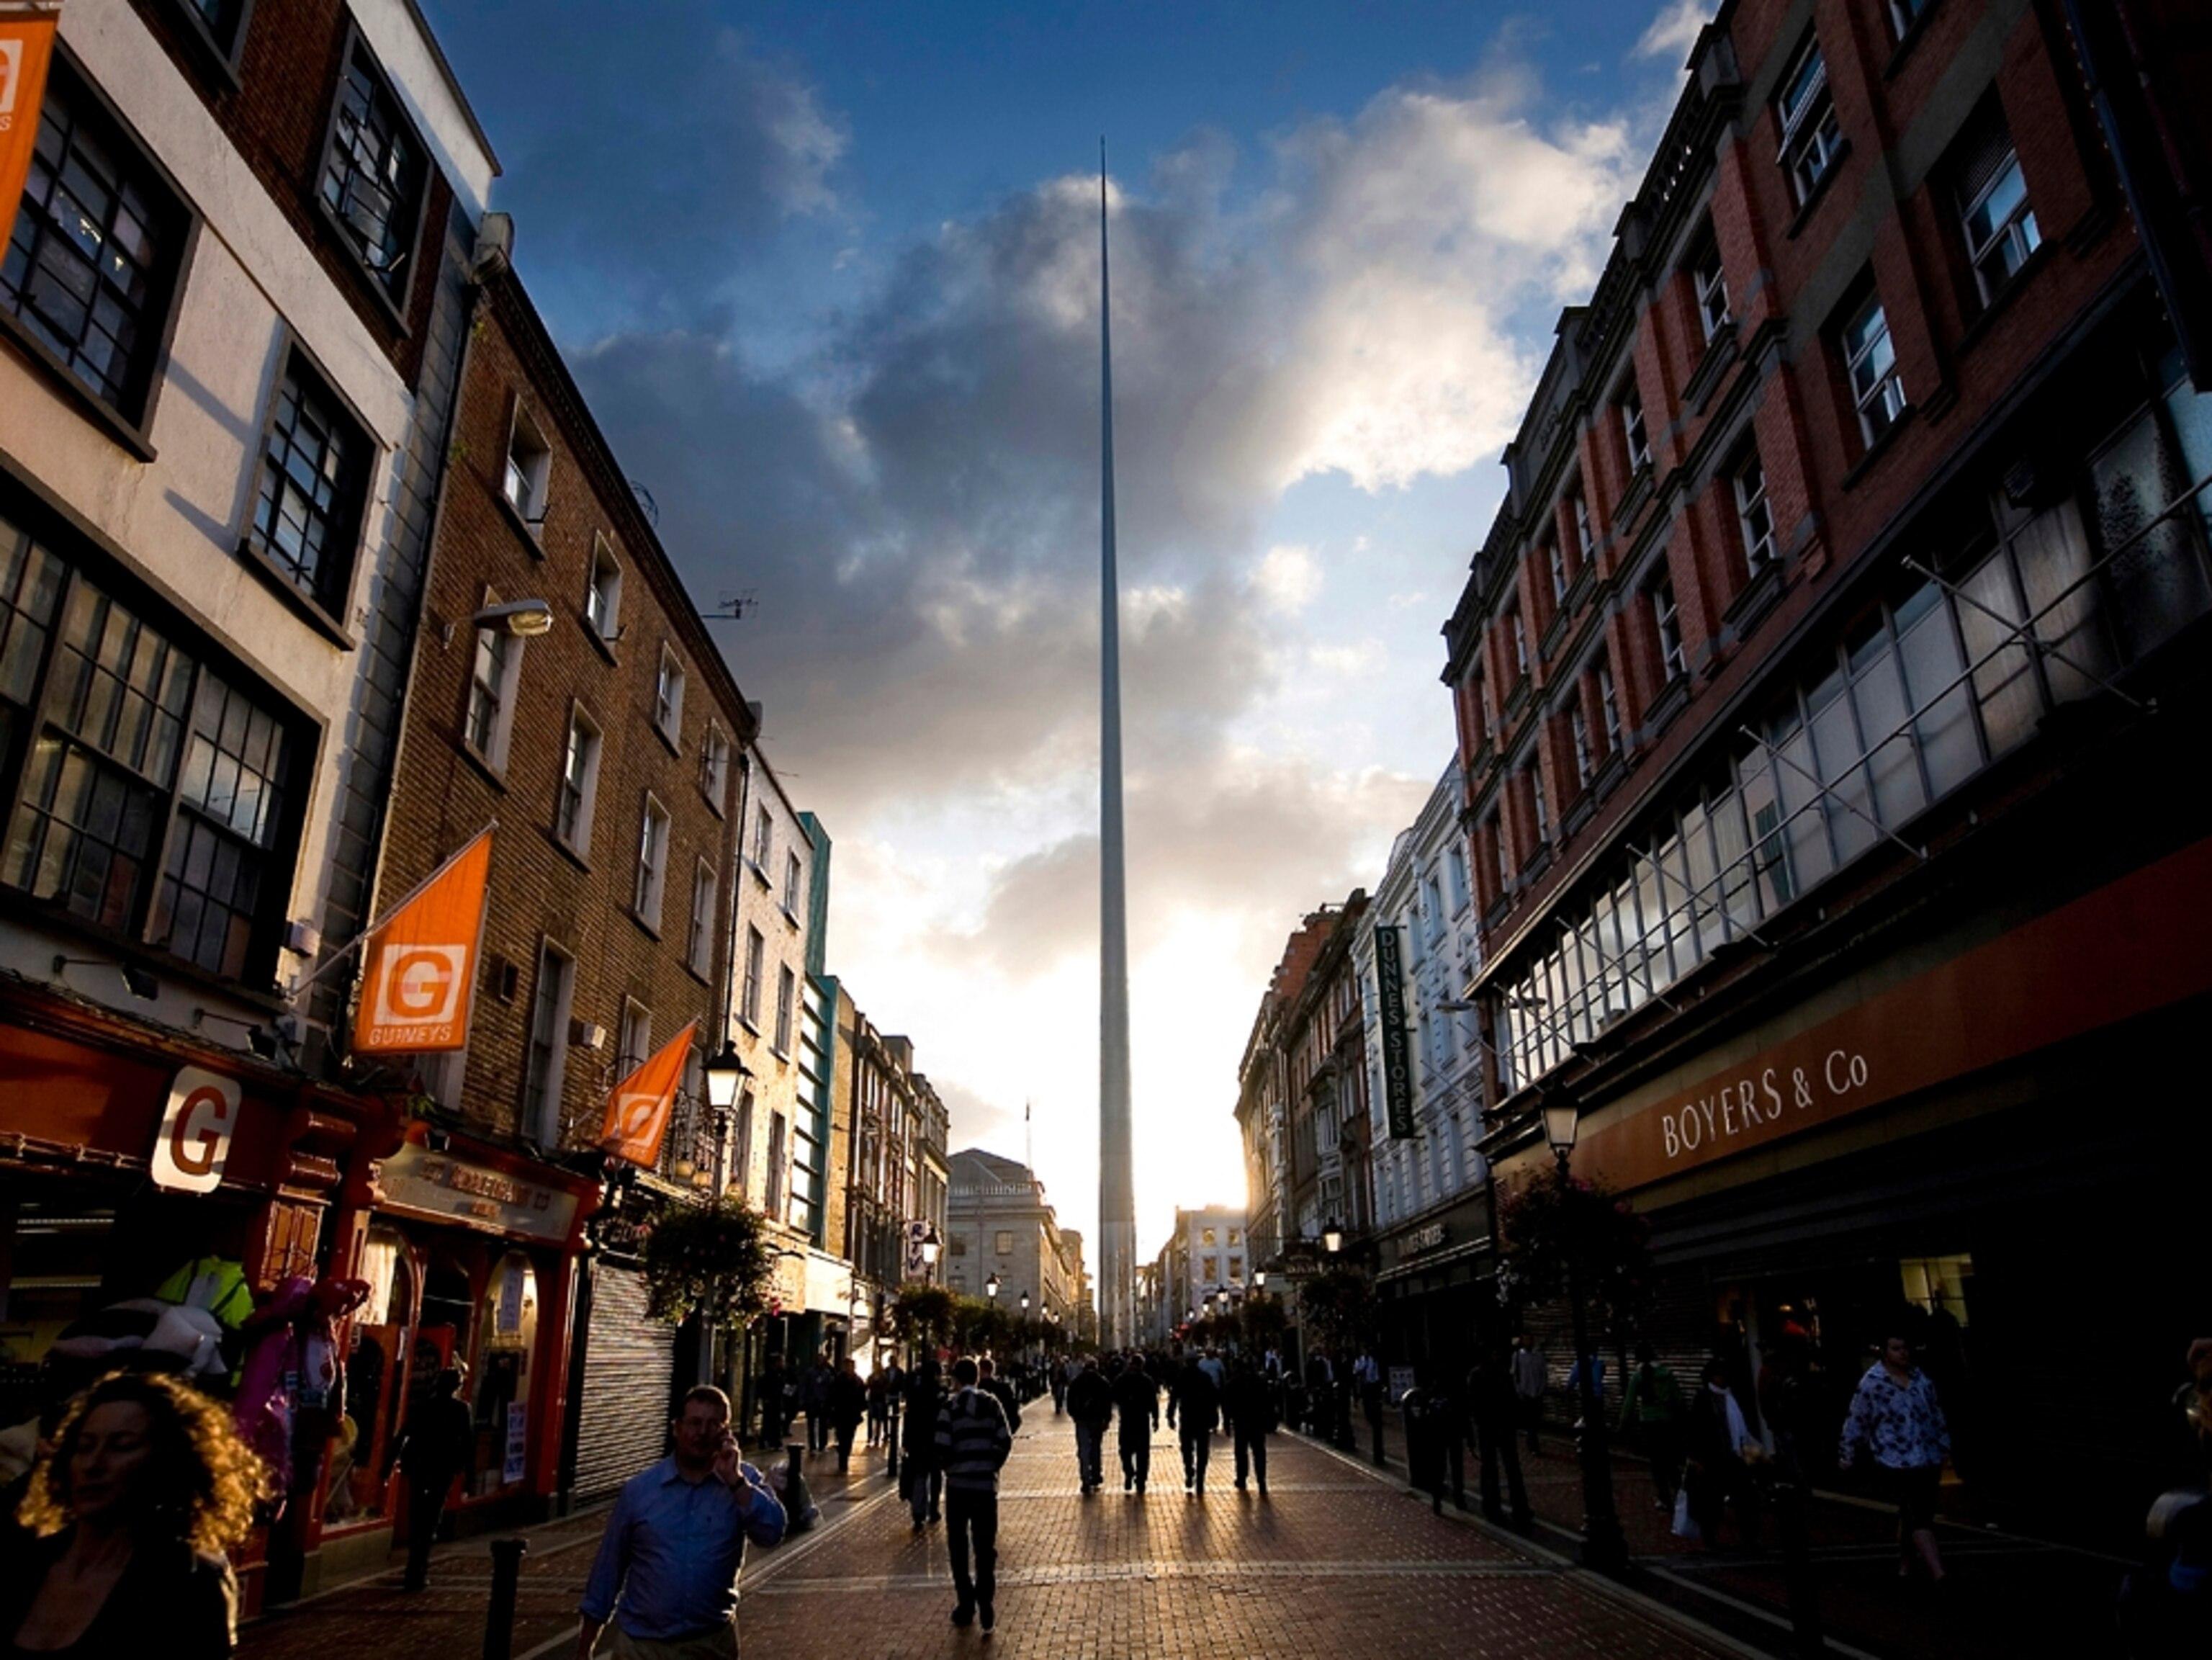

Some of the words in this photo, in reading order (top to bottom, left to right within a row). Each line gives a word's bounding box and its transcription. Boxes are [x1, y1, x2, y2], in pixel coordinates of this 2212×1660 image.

[387, 951, 453, 1018] G
[1382, 930, 1399, 1026] DUNNES
[1390, 1031, 1407, 1131] STORES
[1663, 1069, 1781, 1158] BOYERS
[1793, 1067, 1813, 1108] &
[1825, 1050, 1867, 1095] Co
[170, 1086, 228, 1177] G
